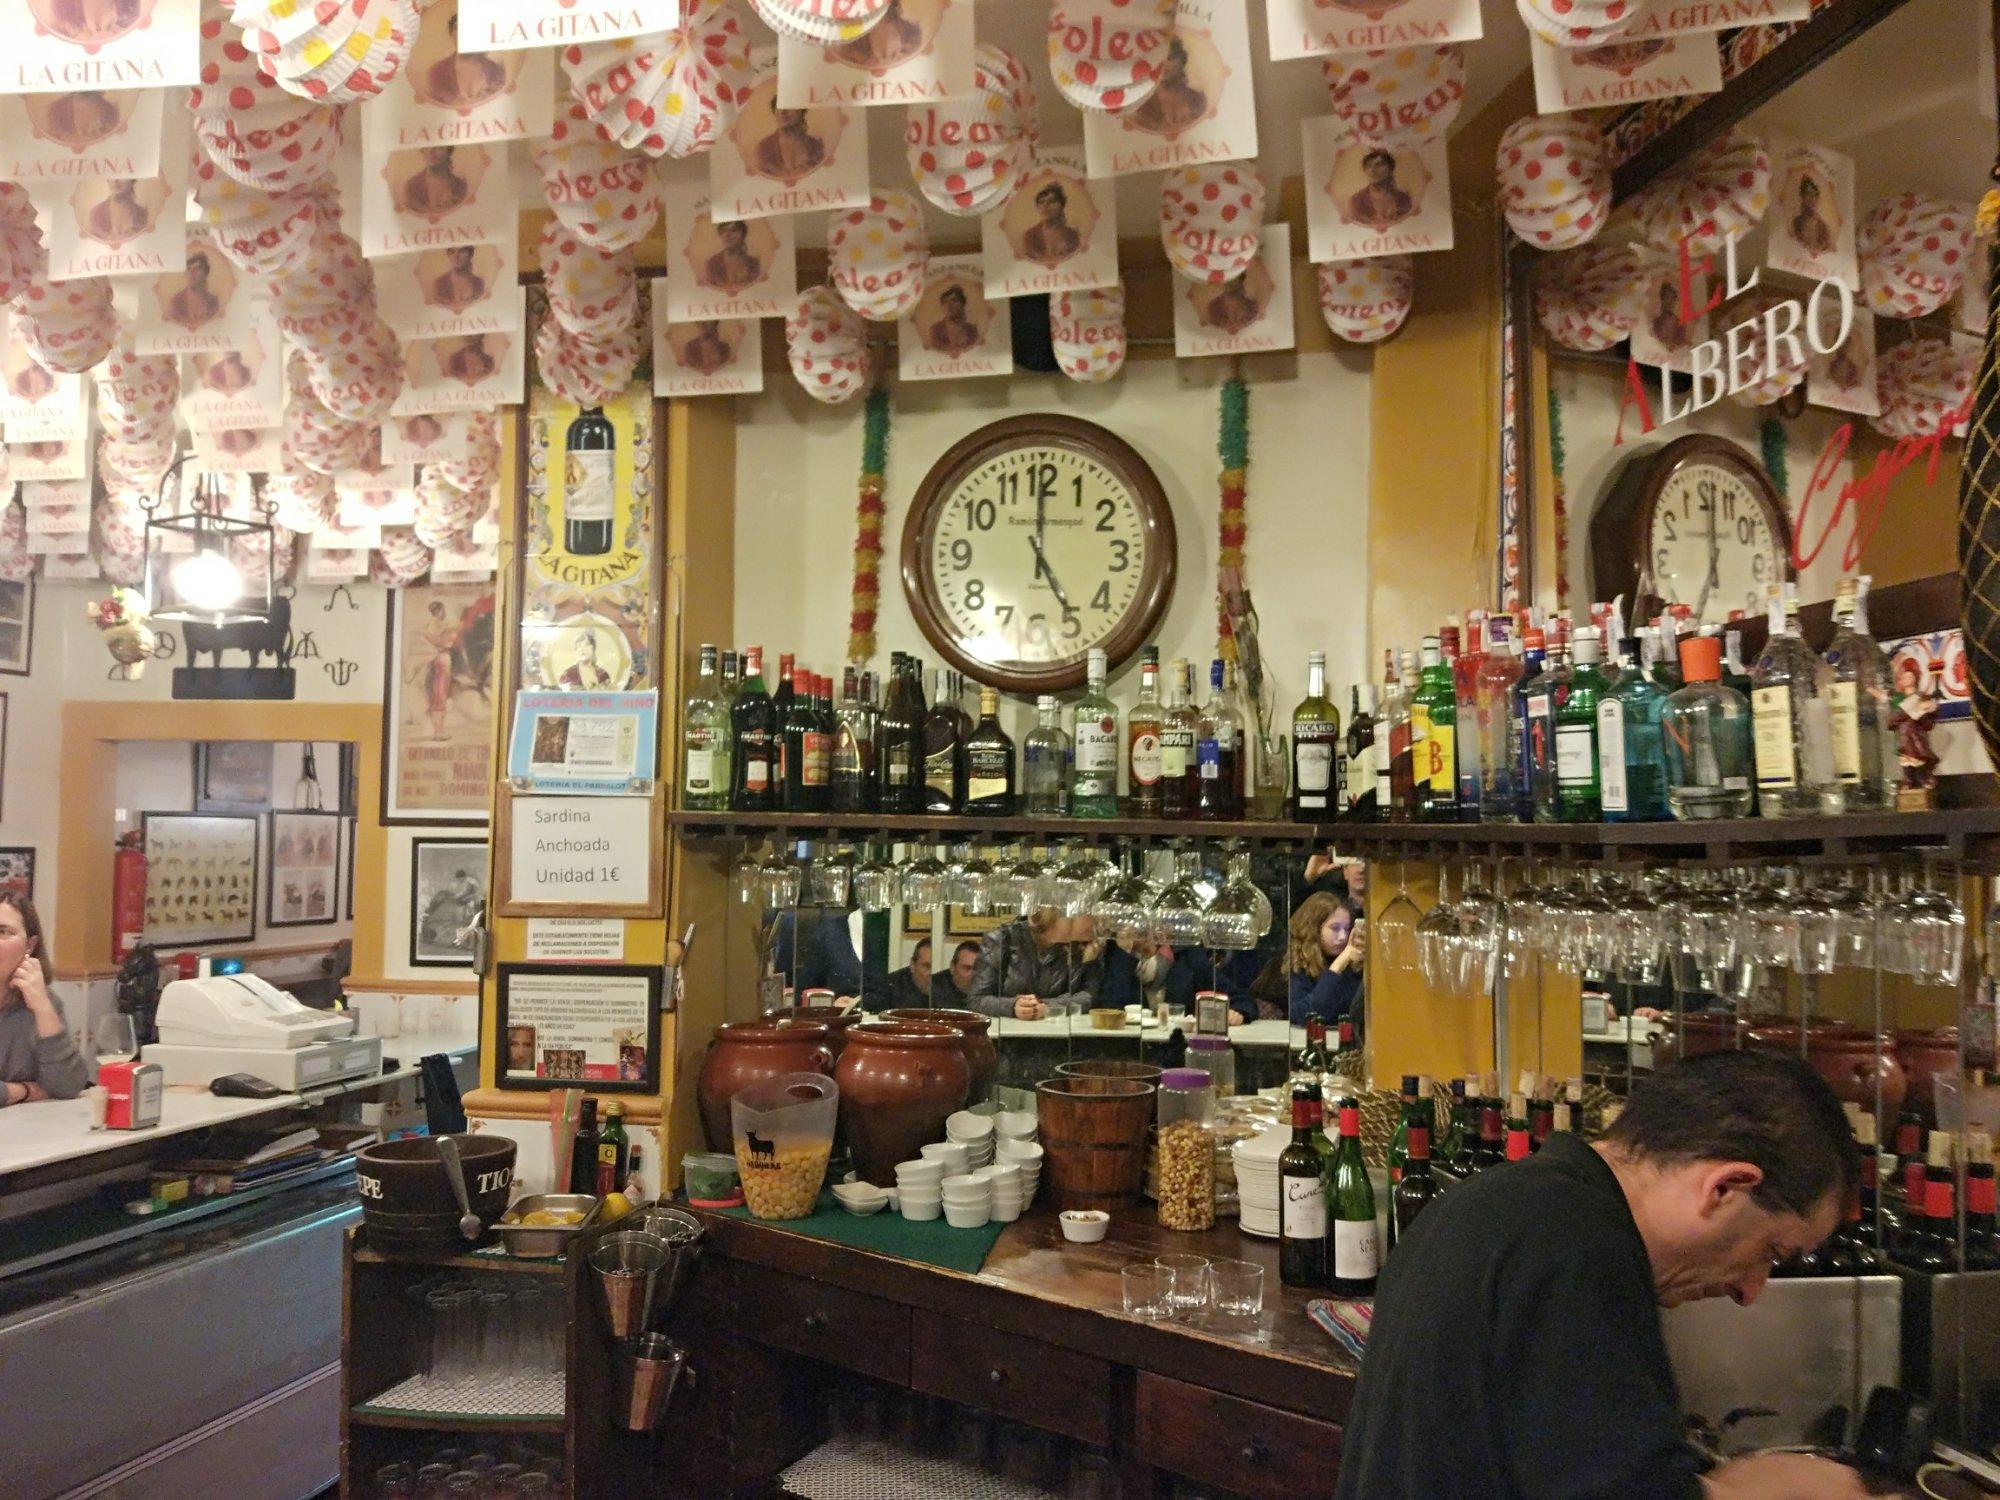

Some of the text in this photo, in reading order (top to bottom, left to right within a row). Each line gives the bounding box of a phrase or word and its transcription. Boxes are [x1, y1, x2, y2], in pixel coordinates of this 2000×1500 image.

[488, 9, 643, 44] LA GITANA
[1670, 1, 1775, 29] GITANA
[1302, 20, 1449, 51] LA GITANA
[19, 57, 166, 86] LA GITANA
[809, 80, 948, 103] LA GITANA
[1562, 74, 1692, 106] LA GITANA
[400, 117, 527, 145] LA GITANA
[12, 157, 136, 177] LA GITANA
[1113, 140, 1232, 172] LA GITANA
[736, 187, 846, 216] LA GITANA
[383, 225, 486, 251] LA GITANA
[1332, 233, 1434, 257] LA GITANA
[68, 253, 164, 275] LA GITANA
[1680, 219, 1760, 325] EL
[1004, 271, 1100, 293] LA GITANA
[687, 300, 778, 317] LA GITANA
[416, 316, 500, 334] LA GITANA
[153, 334, 232, 350] LA GITANA
[1191, 337, 1275, 353] LA GITANA
[914, 359, 994, 376] LA GITANA
[1613, 276, 1854, 447] ALBERO
[692, 377, 745, 390] GITANA
[996, 471, 1018, 505] 11
[1026, 463, 1058, 498] 12
[1072, 474, 1083, 508] 1
[964, 498, 997, 531] 10
[1095, 498, 1117, 532] 2
[538, 546, 640, 586] LA GITANA
[951, 538, 973, 572] 9
[1108, 539, 1130, 573] 3
[963, 578, 985, 611] 8
[1090, 580, 1112, 613] 4
[994, 605, 1015, 630] 7
[1060, 605, 1082, 639] 5
[1295, 723, 1335, 733] RICARD
[534, 808, 592, 825] Sardina
[535, 837, 611, 853] Anchoada
[536, 866, 621, 884] Unidad 1€
[360, 1174, 384, 1200] PE
[477, 1166, 511, 1195] TIO
